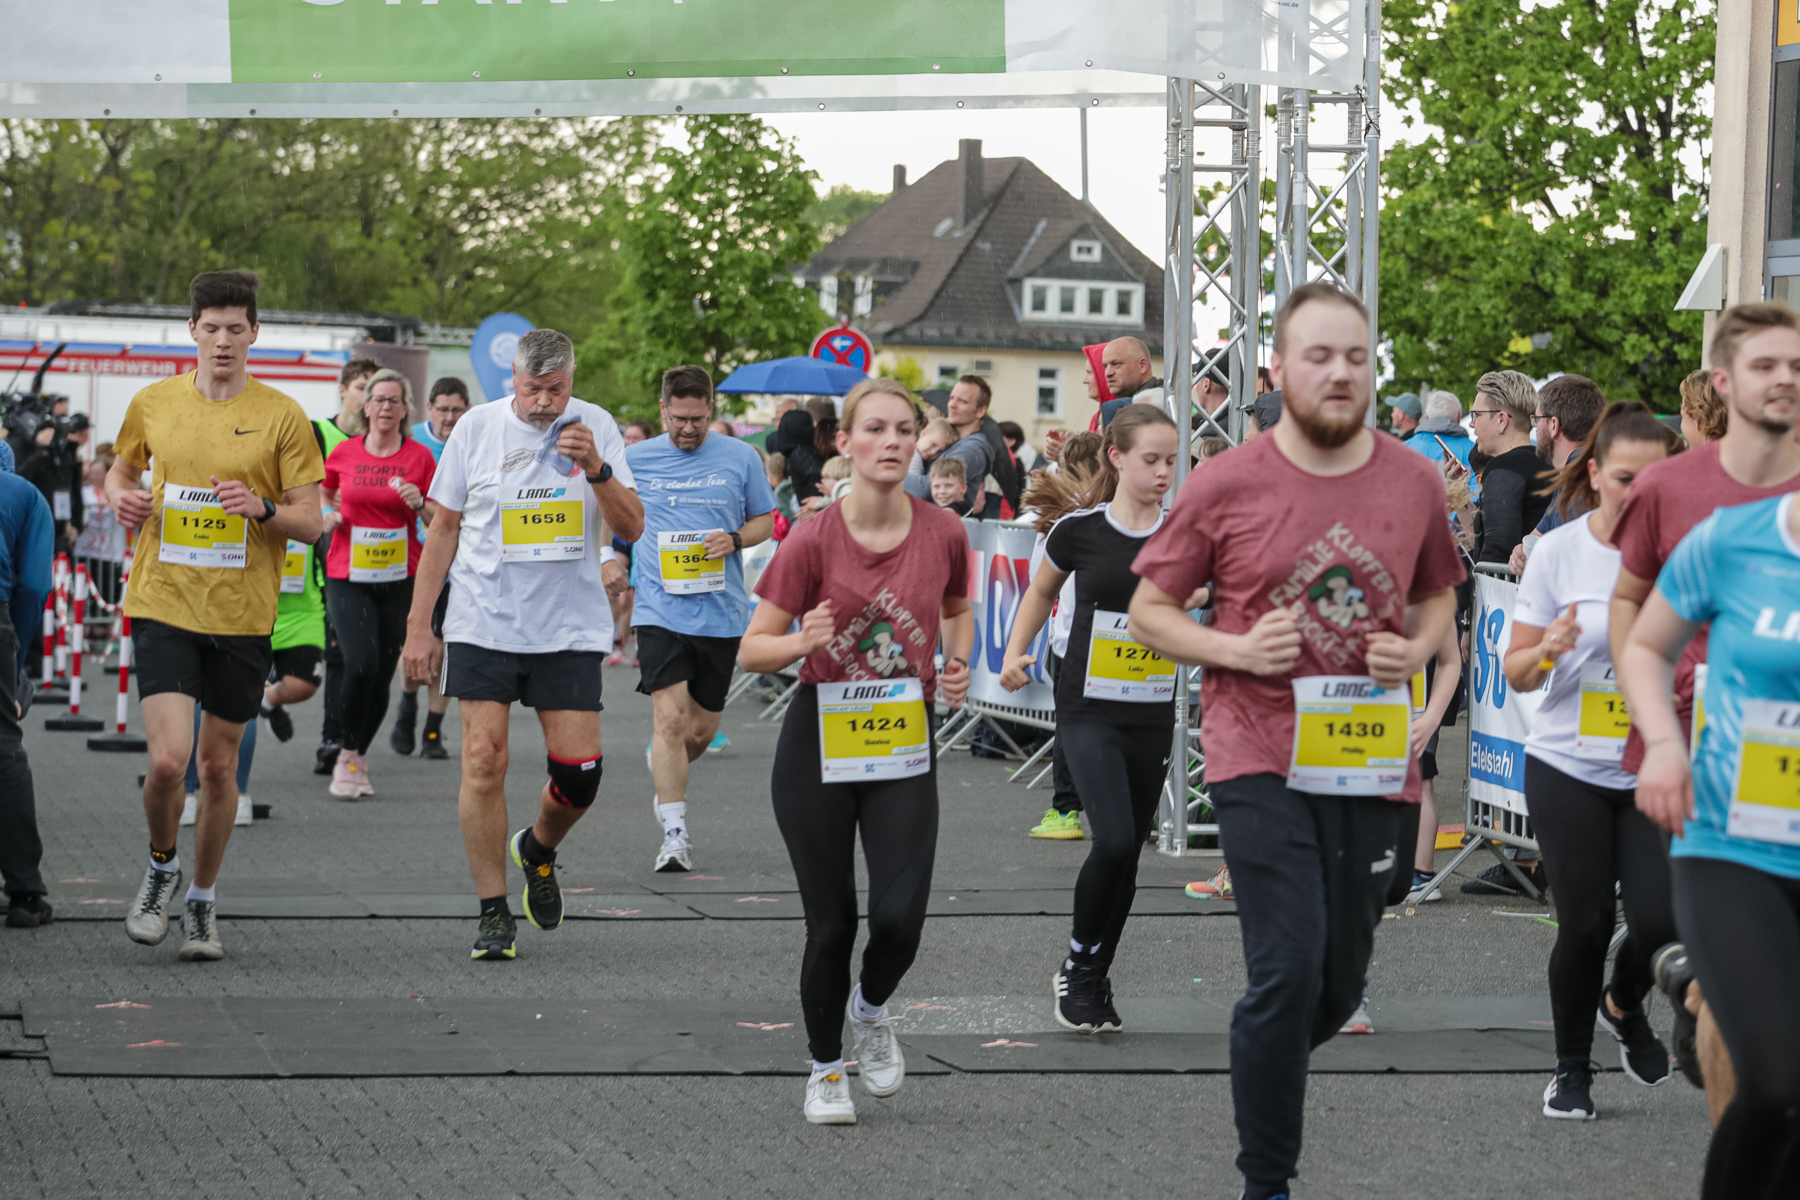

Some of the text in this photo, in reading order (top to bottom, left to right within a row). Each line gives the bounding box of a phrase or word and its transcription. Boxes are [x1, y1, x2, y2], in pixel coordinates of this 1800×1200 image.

[69, 358, 177, 376] FEUERWEHR
[355, 464, 406, 476] SPORTS
[353, 476, 388, 487] CLUB
[650, 474, 727, 490] Ein starkes Team
[517, 488, 553, 500] LANG
[181, 516, 226, 530] 1125
[521, 513, 566, 524] 1658
[364, 531, 388, 540] LANG
[671, 533, 700, 543] LANG
[365, 548, 396, 556] 1597
[673, 554, 709, 563] 1364
[1268, 522, 1395, 607] FAMILIE KLOPFER
[825, 587, 928, 662] FAMILIE KLOPFER
[842, 684, 889, 700] LANG
[1322, 682, 1371, 698] LANG
[846, 717, 908, 732] 1424
[1325, 722, 1385, 738] 1430
